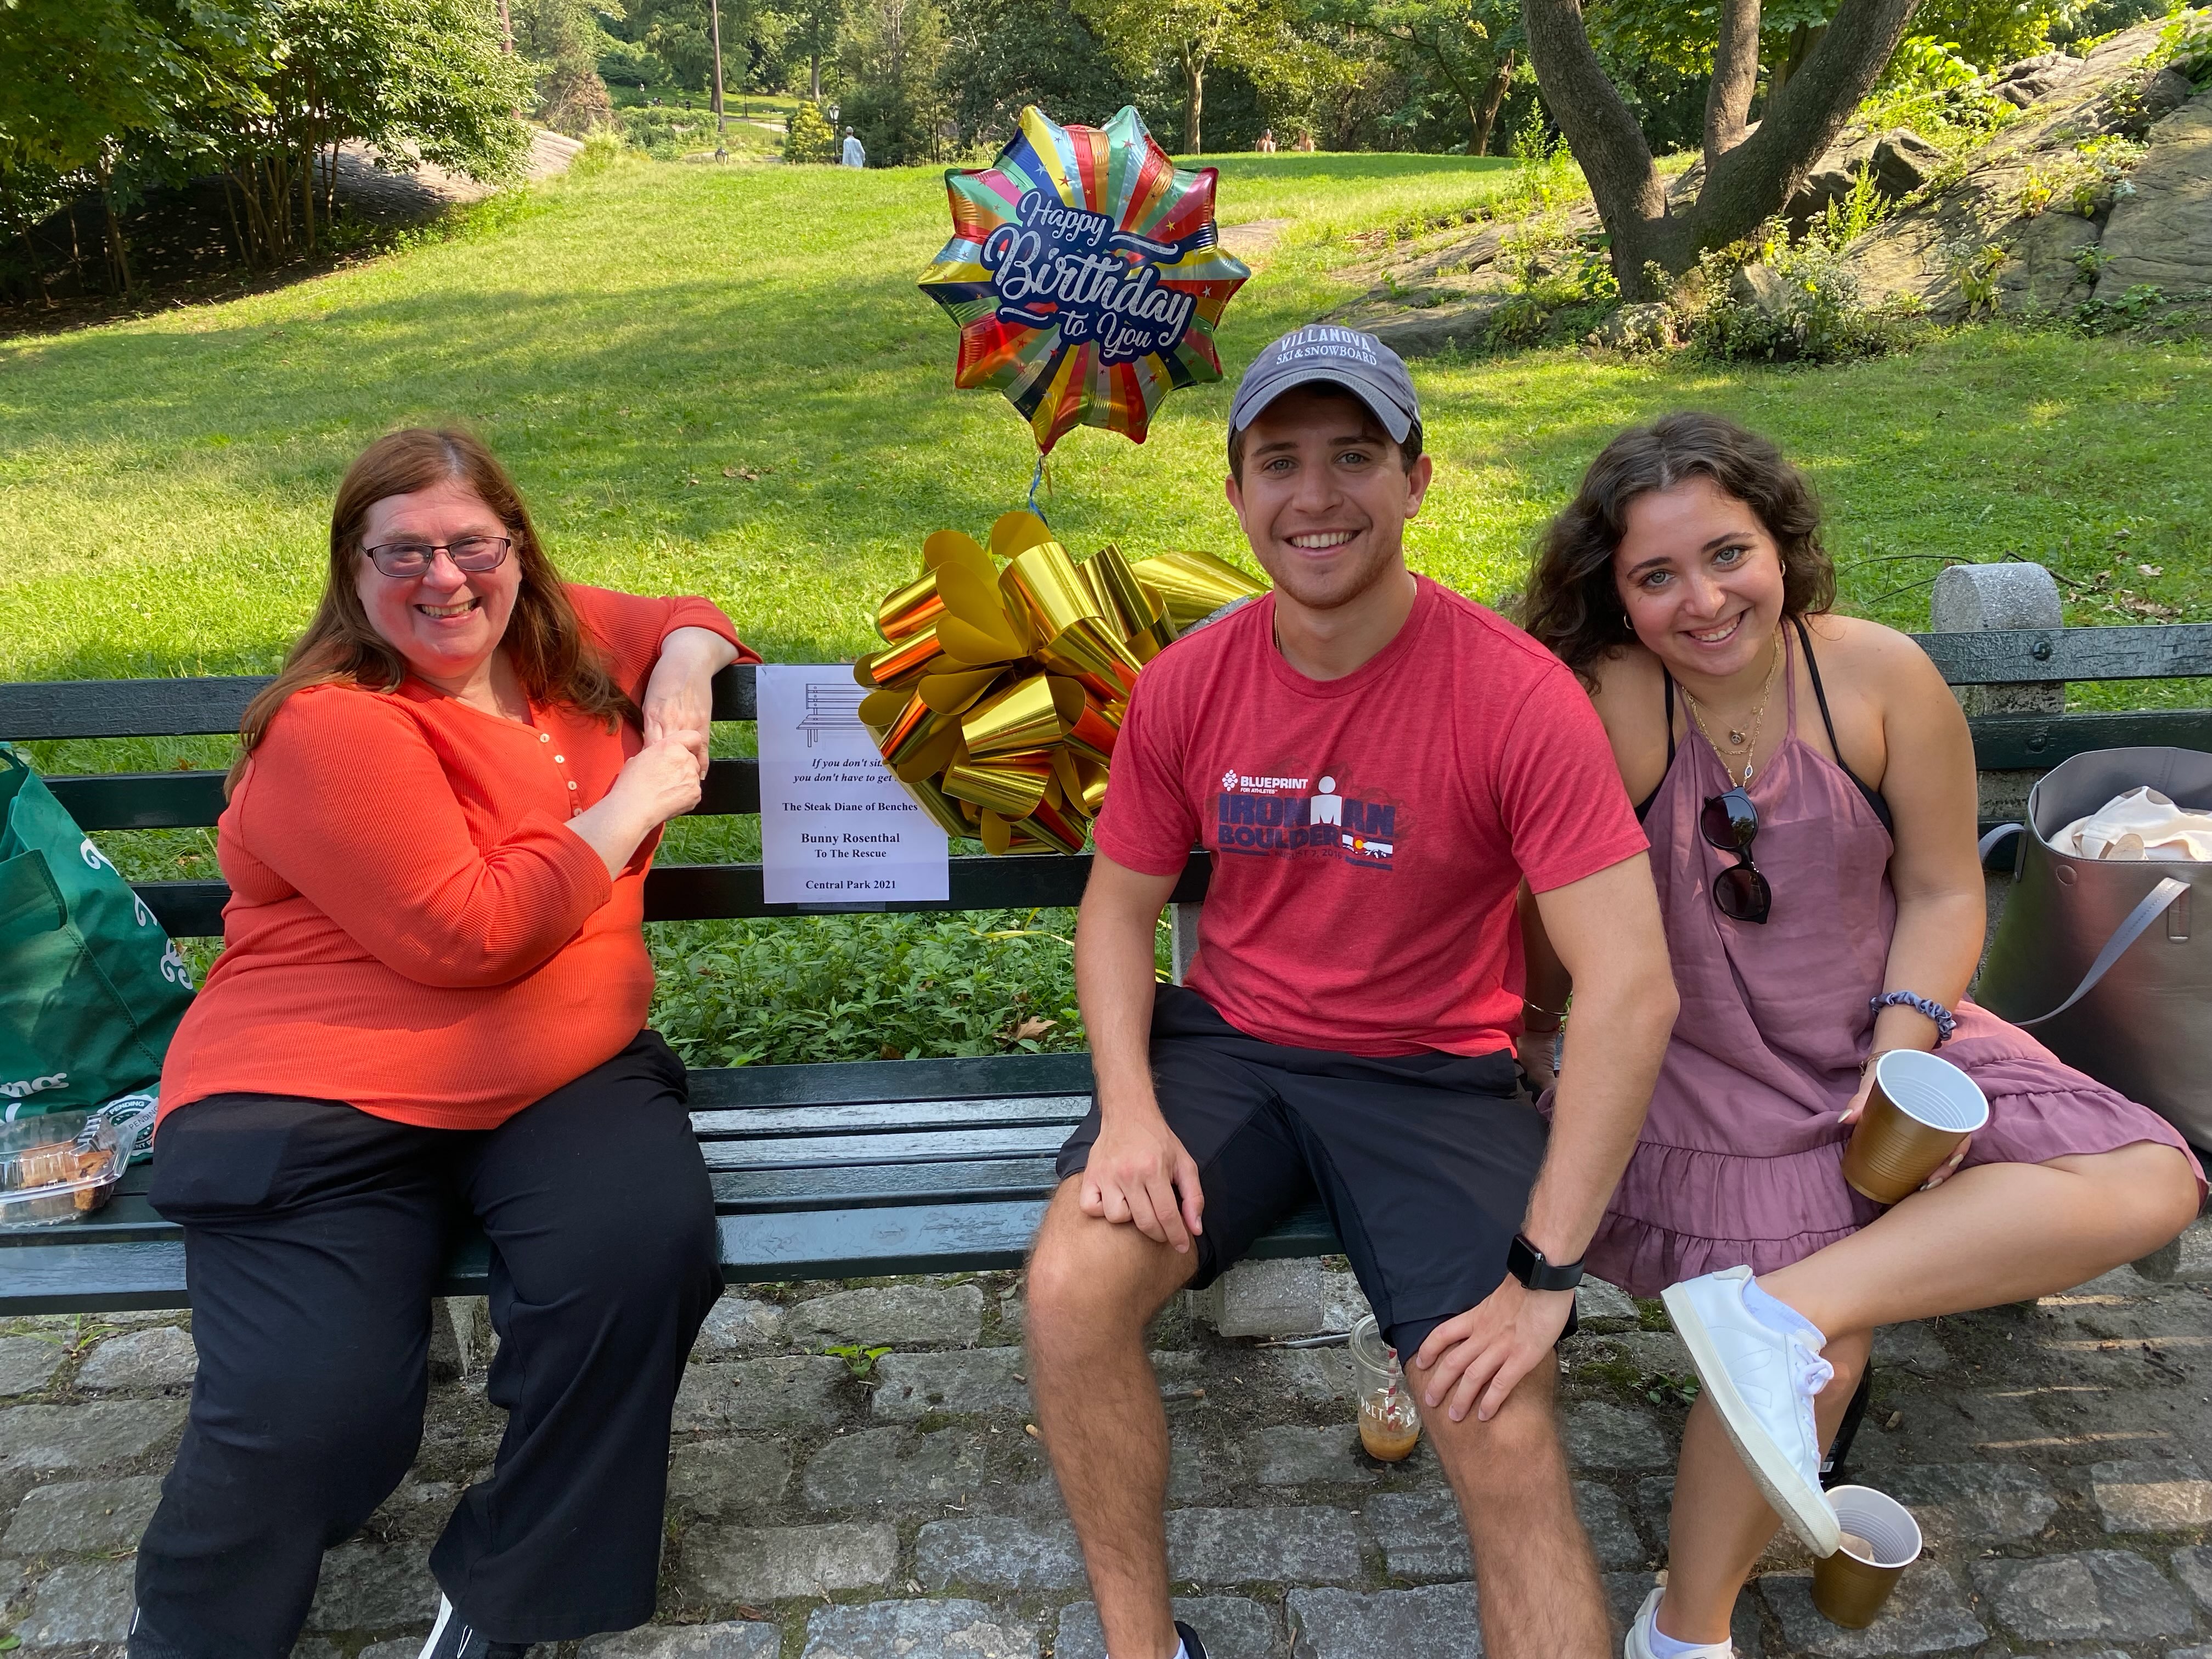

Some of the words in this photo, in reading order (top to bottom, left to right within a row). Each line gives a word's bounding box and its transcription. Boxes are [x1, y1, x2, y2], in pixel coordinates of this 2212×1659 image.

[1019, 190, 1108, 246] Happy
[983, 225, 1193, 347] Birthday
[1058, 309, 1090, 337] to
[1096, 312, 1152, 358] You
[1281, 328, 1372, 353] VILLANOVA
[812, 758, 822, 769] If
[822, 760, 840, 769] you
[843, 758, 867, 768] don't
[793, 775, 811, 784] you
[814, 773, 839, 782] don't
[841, 773, 864, 782] have
[877, 774, 893, 784] get
[1240, 776, 1309, 789] BLUEPRINT
[782, 802, 802, 811] The
[804, 802, 832, 811] Steak
[834, 802, 863, 811] Diane
[865, 802, 876, 811] of
[877, 802, 918, 811] Benches
[1218, 793, 1397, 837] IRONMAN
[800, 833, 839, 846] Bunny
[842, 832, 901, 843] Rosenthal
[1218, 824, 1340, 851] BOULDER
[814, 849, 827, 858] To
[830, 849, 850, 858] The
[852, 849, 887, 858] Rescue
[805, 880, 844, 889] Central
[847, 880, 871, 889] Park
[873, 880, 896, 889] 2021
[109, 1101, 145, 1115] PENDING
[1361, 1395, 1384, 1421] PRET
